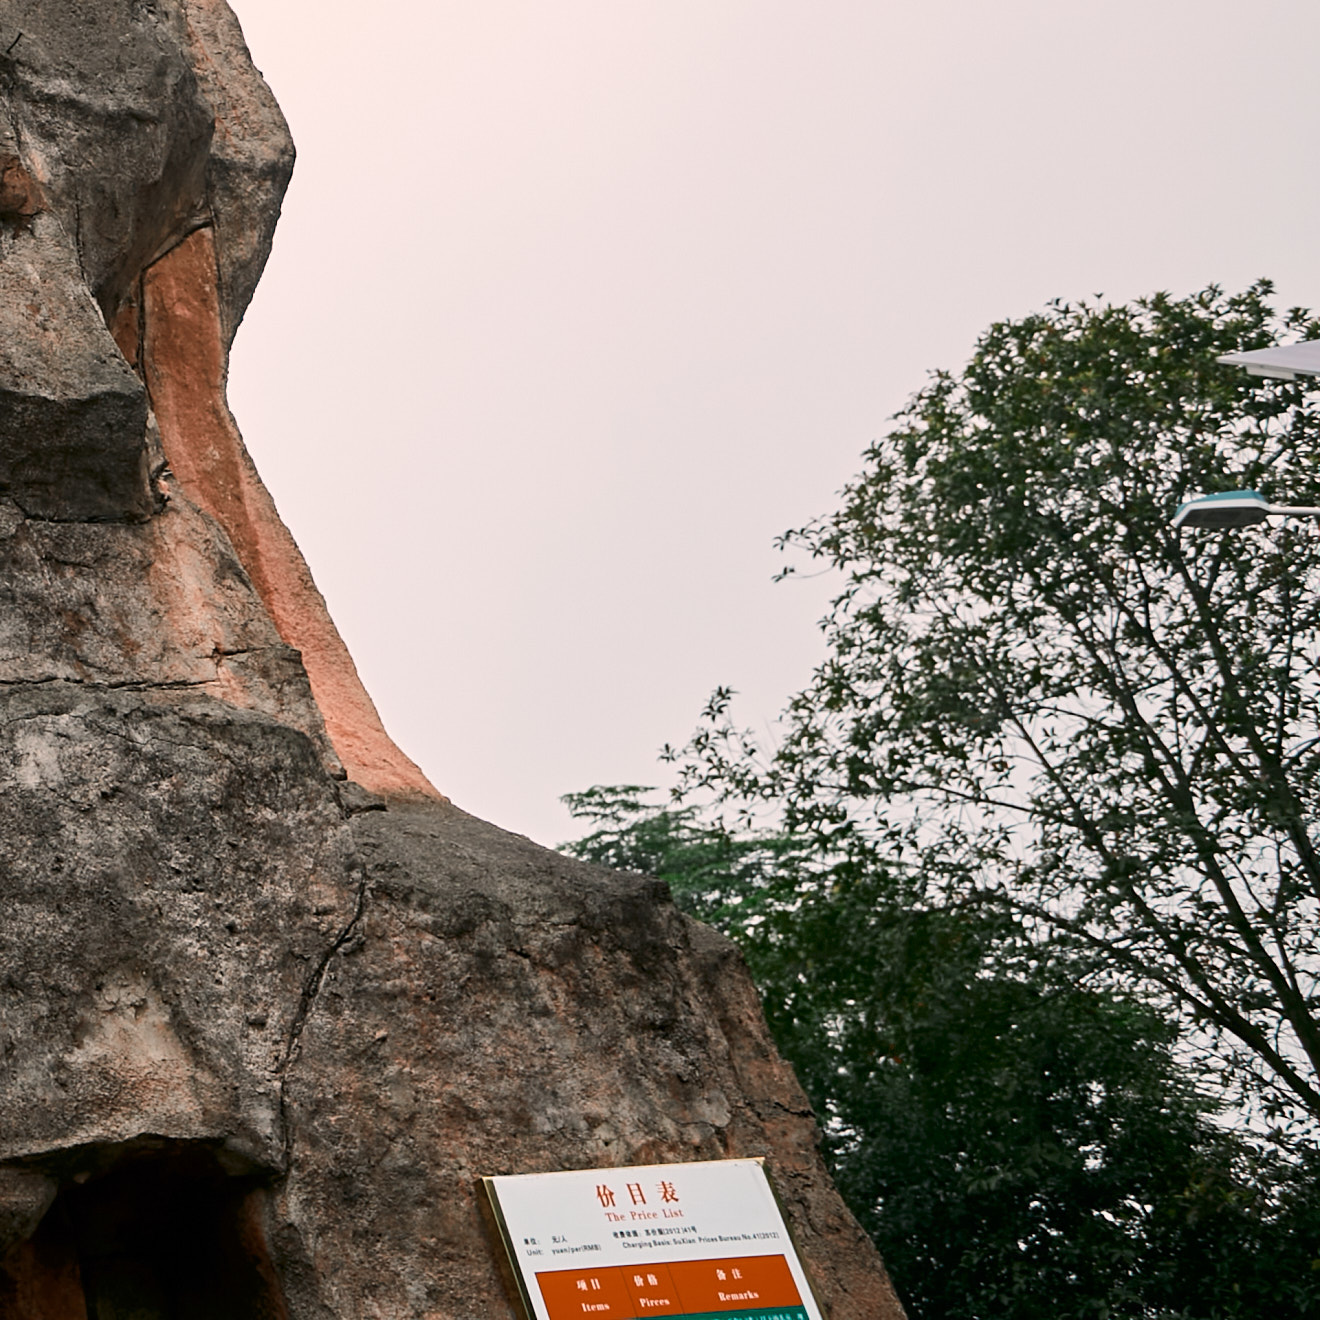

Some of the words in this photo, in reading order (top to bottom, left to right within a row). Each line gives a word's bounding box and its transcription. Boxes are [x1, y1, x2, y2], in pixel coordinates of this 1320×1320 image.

[596, 1181, 679, 1207] 价目表
[605, 1212, 626, 1222] The
[629, 1209, 658, 1220] Price
[662, 1208, 684, 1218] List
[622, 1240, 653, 1250] Charging
[581, 1302, 610, 1313] Items
[639, 1297, 671, 1308] Pirces
[718, 1290, 760, 1302] Remarks
